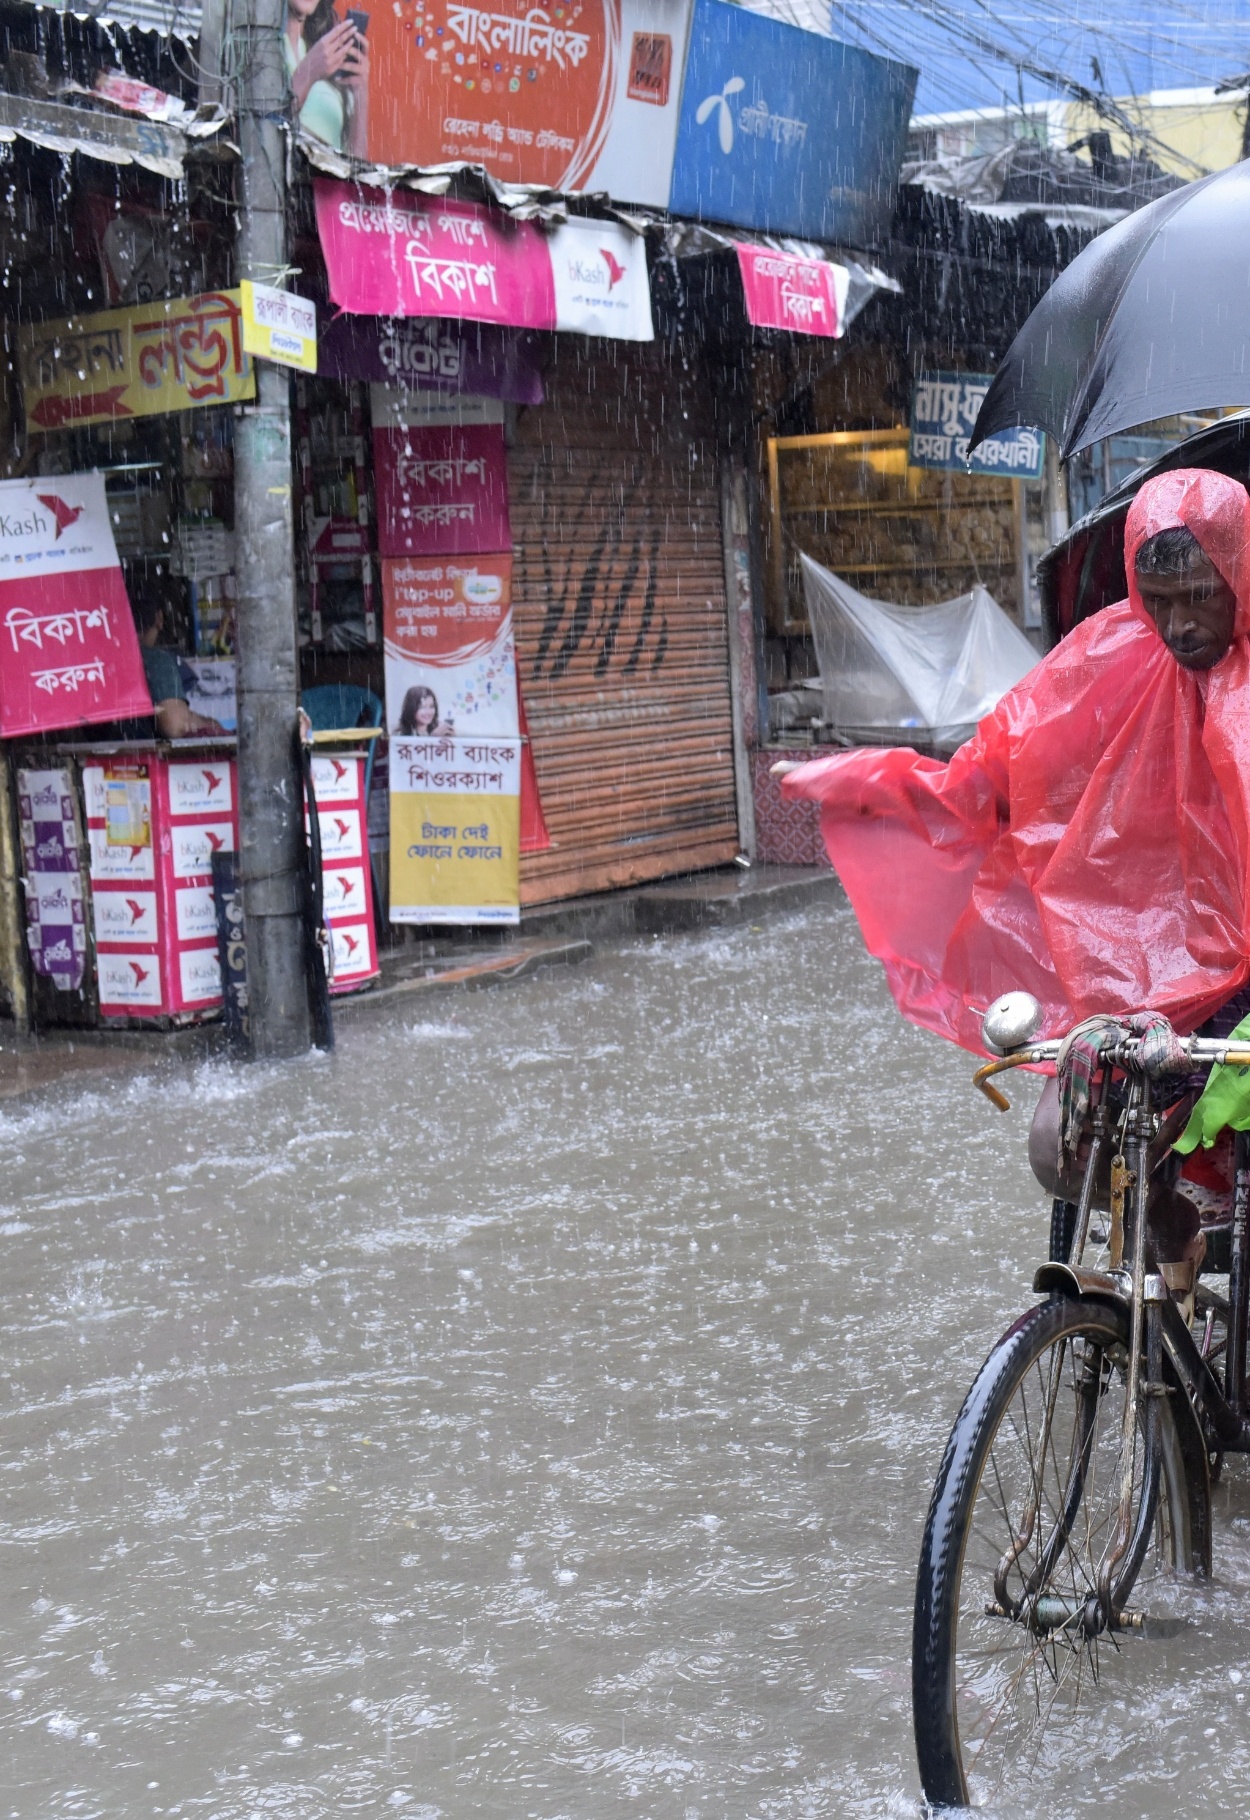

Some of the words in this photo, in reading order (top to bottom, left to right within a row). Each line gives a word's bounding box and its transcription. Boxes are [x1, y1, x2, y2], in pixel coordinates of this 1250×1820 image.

[447, 3, 590, 69] বাংলালিংক
[339, 201, 432, 238] প্রয়োজনে
[438, 216, 488, 248] পাশে
[404, 241, 498, 305] বিকাশ
[567, 259, 605, 284] bKash
[780, 281, 826, 324] বিকাশ
[913, 433, 952, 461] সেরা
[397, 453, 486, 487] বিকাশ
[413, 503, 475, 526] করুন
[3, 606, 112, 653] বিকাশ
[30, 658, 106, 695] করুন
[397, 738, 455, 762] রূপালী
[463, 746, 515, 764] ব্যাংক
[408, 765, 503, 790] শিওরক্যাশ
[421, 822, 457, 839] টাকা
[462, 823, 489, 841] দেই
[407, 845, 451, 860] ফোনে
[457, 845, 502, 860] ফোনে
